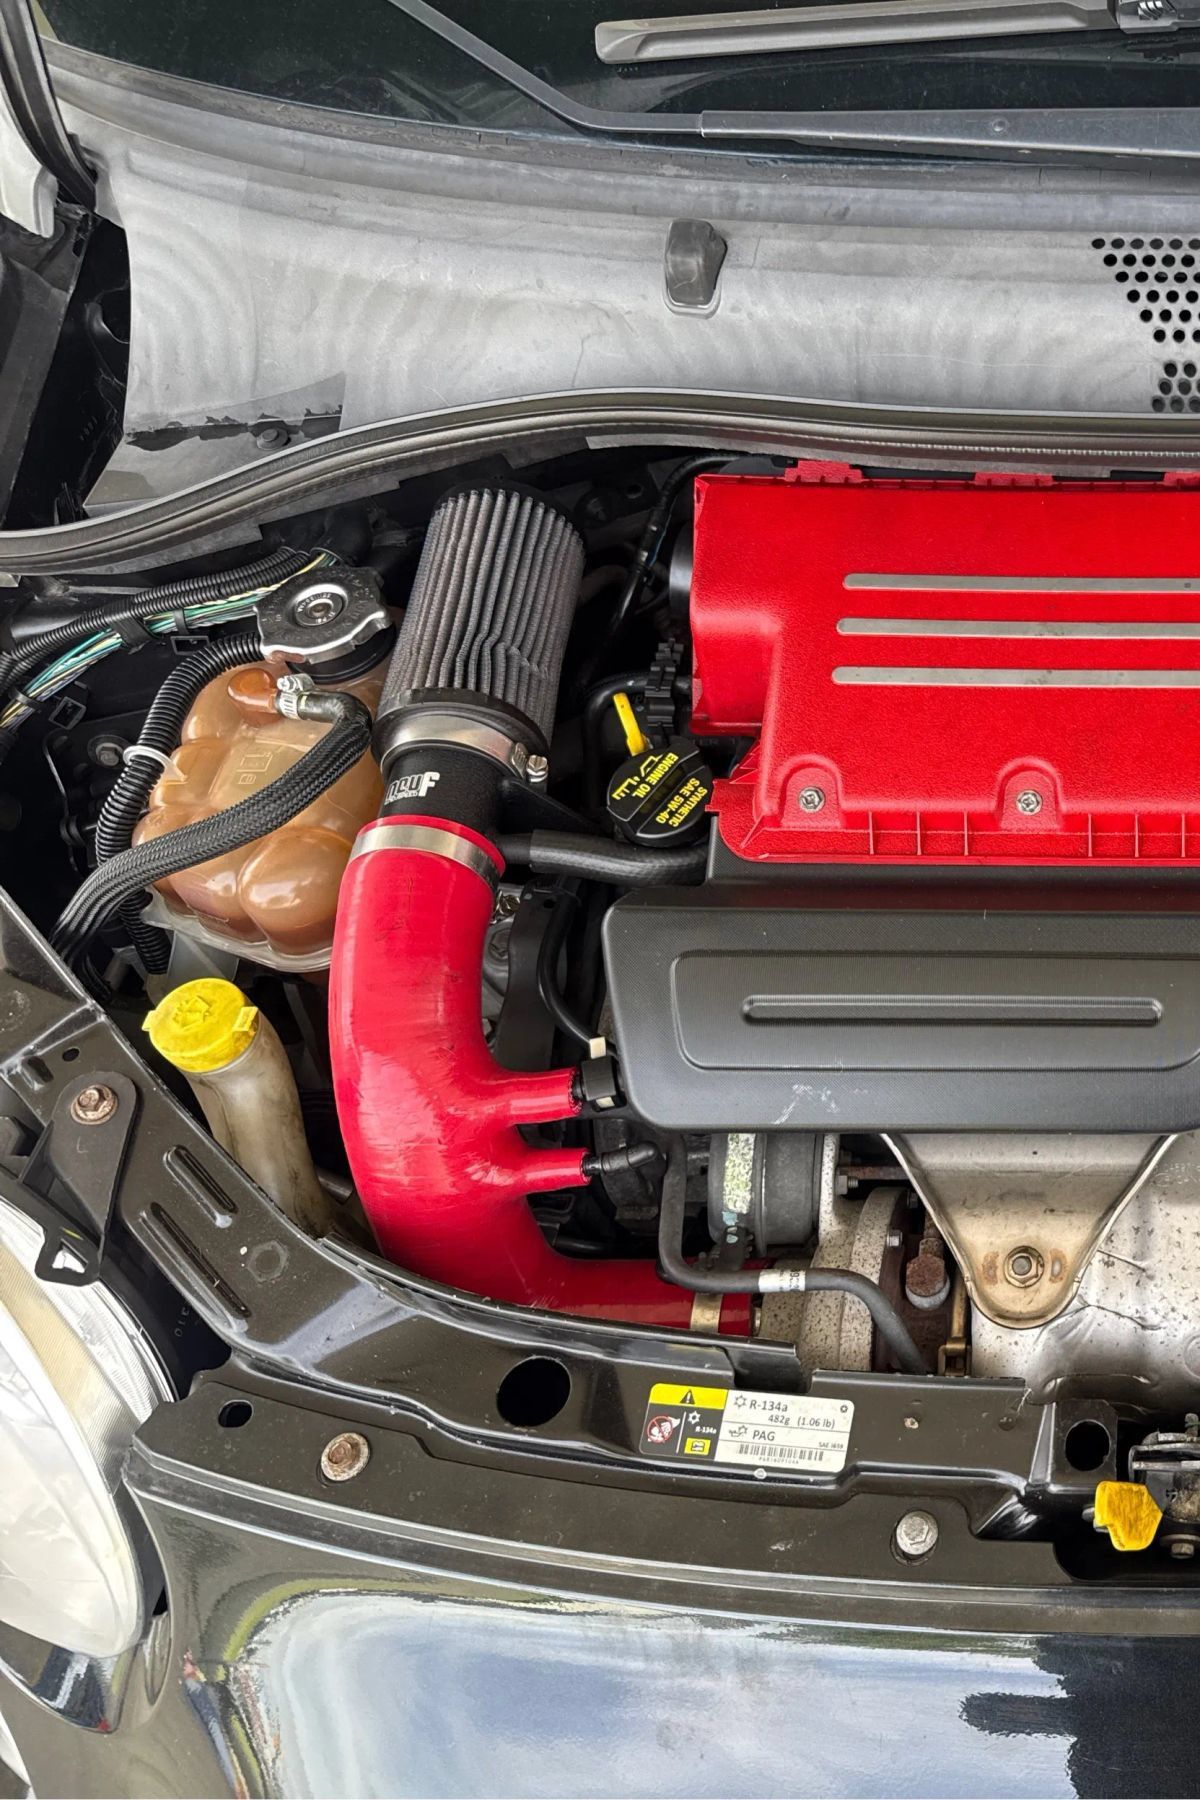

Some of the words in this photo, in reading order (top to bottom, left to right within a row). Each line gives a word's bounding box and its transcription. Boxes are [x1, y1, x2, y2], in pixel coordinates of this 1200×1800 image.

[645, 752, 679, 786] ENGINE
[632, 783, 651, 798] OIL
[679, 778, 700, 797] SAE
[655, 795, 684, 824] 5W-40
[668, 786, 708, 827] SYNTHETIC
[749, 1400, 788, 1413] R-134a
[768, 1414, 790, 1426] 482g
[797, 1414, 820, 1427] (1.06
[822, 1416, 835, 1429] lb)
[752, 1429, 775, 1442] PAG
